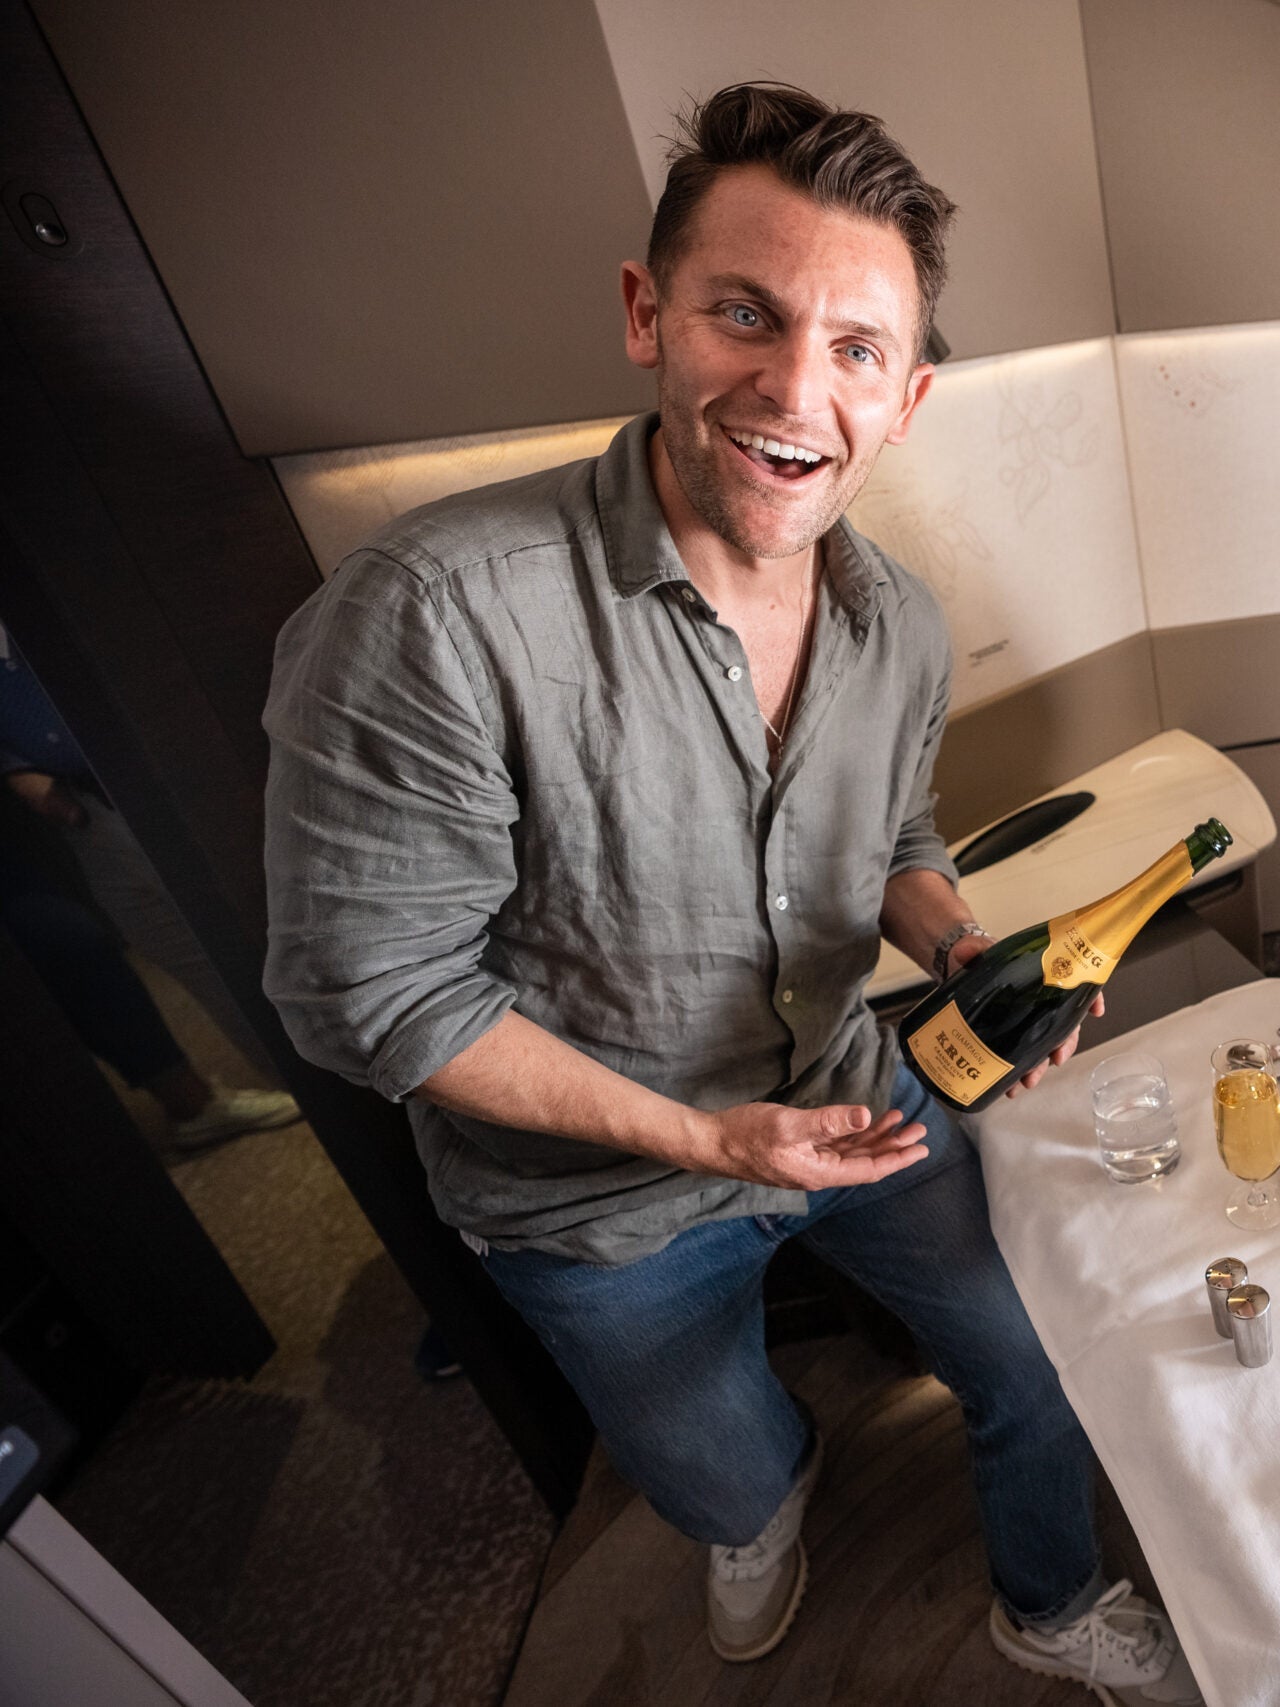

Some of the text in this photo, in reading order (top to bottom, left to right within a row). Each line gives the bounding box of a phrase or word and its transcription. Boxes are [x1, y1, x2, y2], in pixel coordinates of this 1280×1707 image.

[1065, 926, 1104, 968] KRUG
[935, 1030, 981, 1081] KRUG
[951, 1028, 987, 1066] CHAMPAGNE
